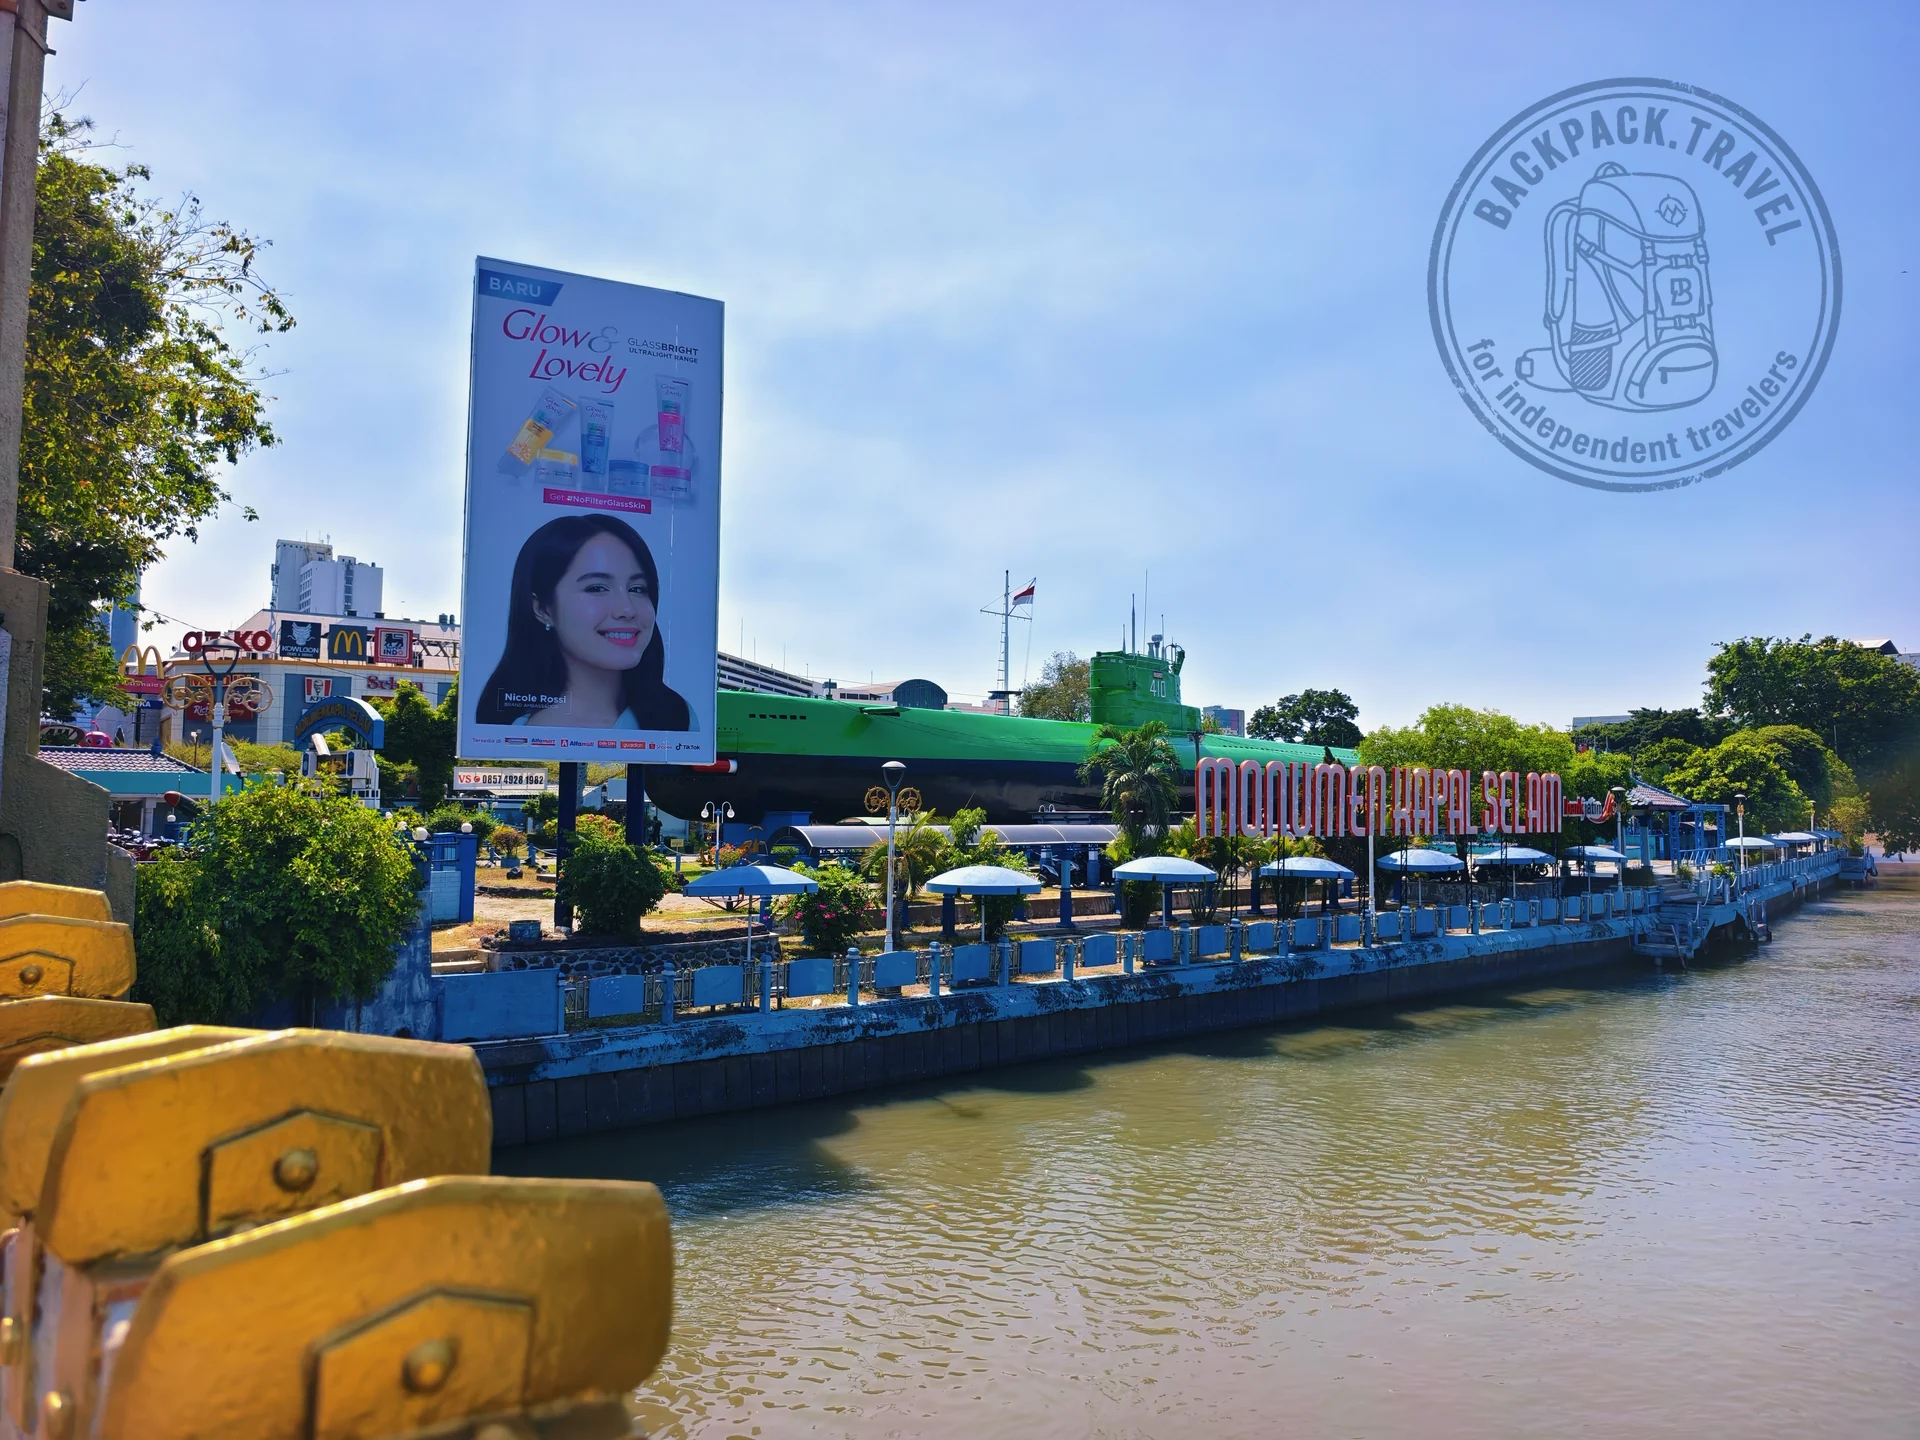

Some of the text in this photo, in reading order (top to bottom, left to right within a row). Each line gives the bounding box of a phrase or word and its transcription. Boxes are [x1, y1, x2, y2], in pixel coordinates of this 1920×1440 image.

[488, 277, 541, 298] BARU
[502, 309, 591, 349] Glow
[628, 338, 699, 356] GLASSBRIGHT
[629, 347, 698, 364] ULTRALIGHT RANGE
[529, 348, 627, 394] Lovely
[549, 493, 646, 510] Get #NoFilterGlassSkin
[282, 645, 319, 654] KOWLOON
[383, 648, 404, 656] INDO
[1149, 679, 1166, 698] 410
[504, 692, 567, 704] Nicole Rossi
[458, 774, 544, 785] VS 0857 4928 1982
[1391, 767, 1478, 836] KAPAL
[1481, 770, 1562, 834] SELAM
